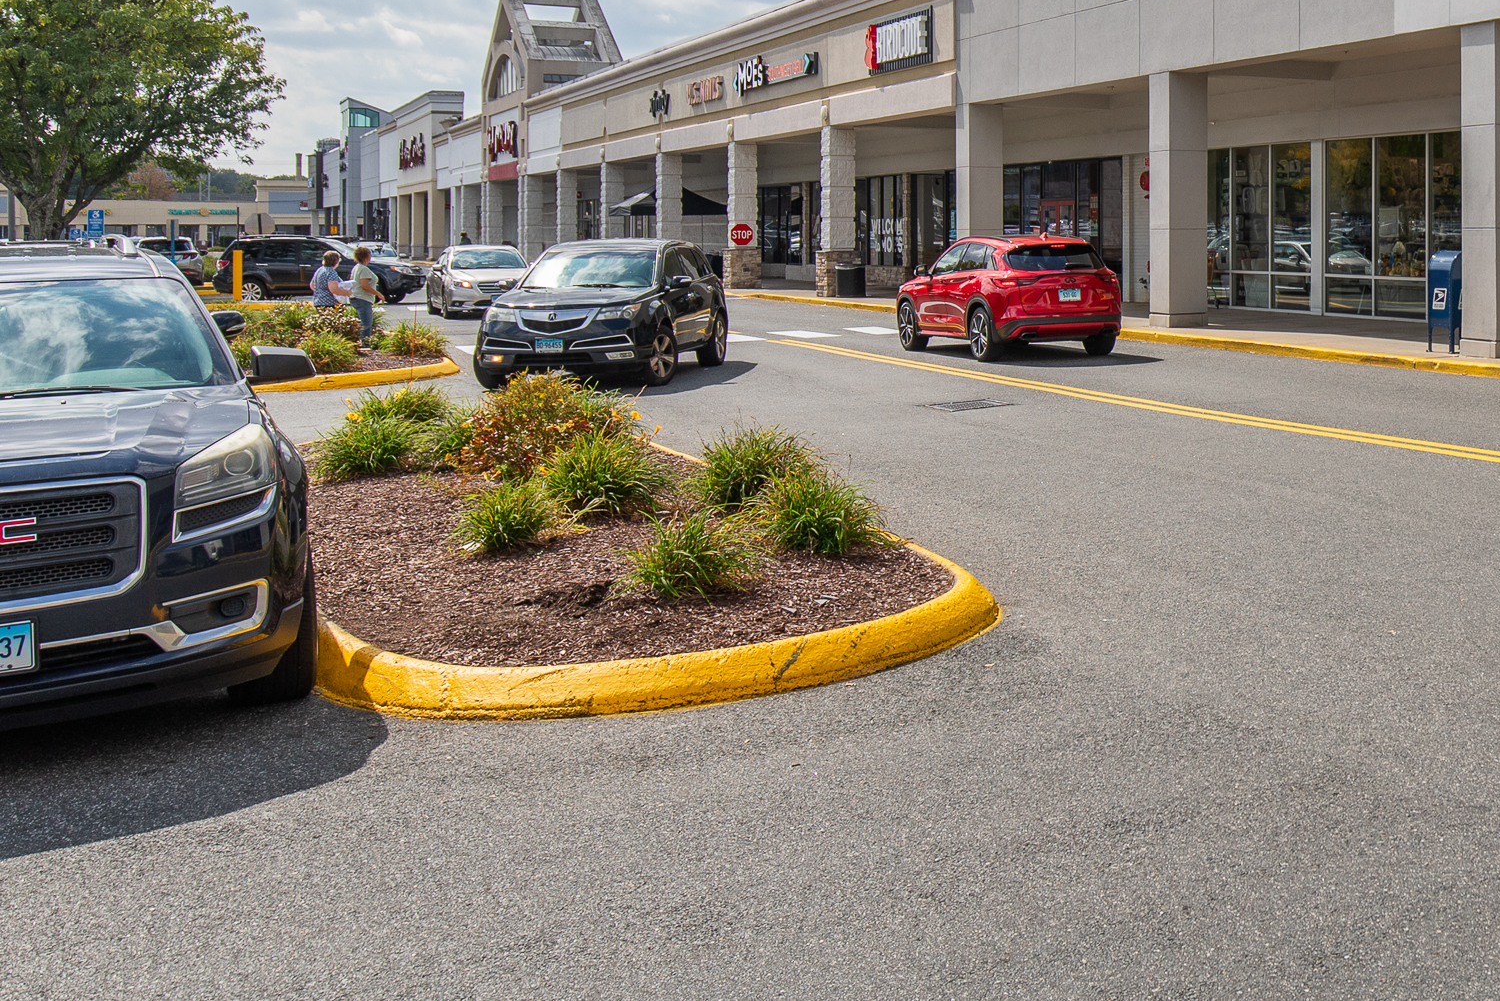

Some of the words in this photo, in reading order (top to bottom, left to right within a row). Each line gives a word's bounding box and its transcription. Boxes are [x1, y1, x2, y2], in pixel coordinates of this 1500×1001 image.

[875, 15, 928, 64] BIRDCODE
[731, 230, 753, 240] STOP
[870, 218, 905, 235] WELCOM
